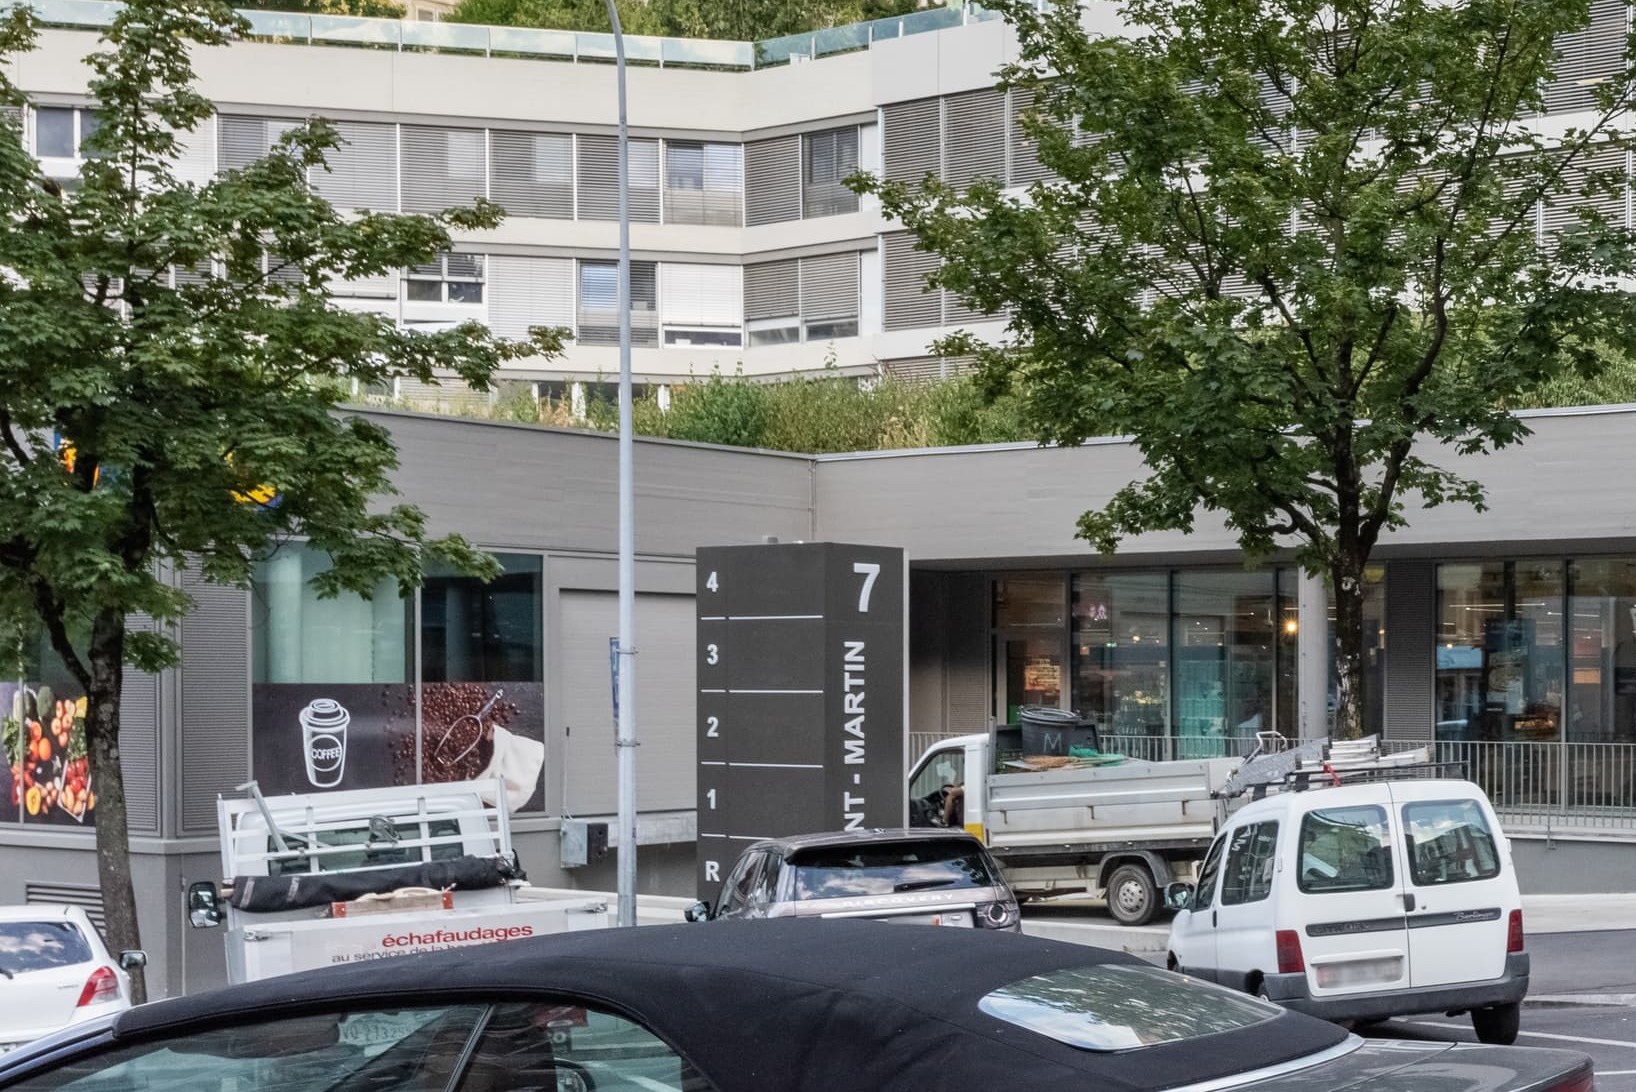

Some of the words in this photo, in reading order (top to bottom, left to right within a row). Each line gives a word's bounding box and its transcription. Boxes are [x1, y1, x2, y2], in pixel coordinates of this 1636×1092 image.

[706, 572, 719, 593] 4
[853, 562, 880, 613] 7
[706, 643, 719, 665] 3
[844, 641, 865, 765] MARTIN
[706, 716, 719, 738] 2
[311, 748, 341, 760] COFFEE
[706, 788, 717, 810] 1
[844, 791, 865, 833] NT
[705, 860, 720, 882] R
[844, 894, 953, 907] DISCOVERY
[381, 925, 534, 948] échafaudages
[331, 954, 350, 963] au
[353, 948, 406, 962] service
